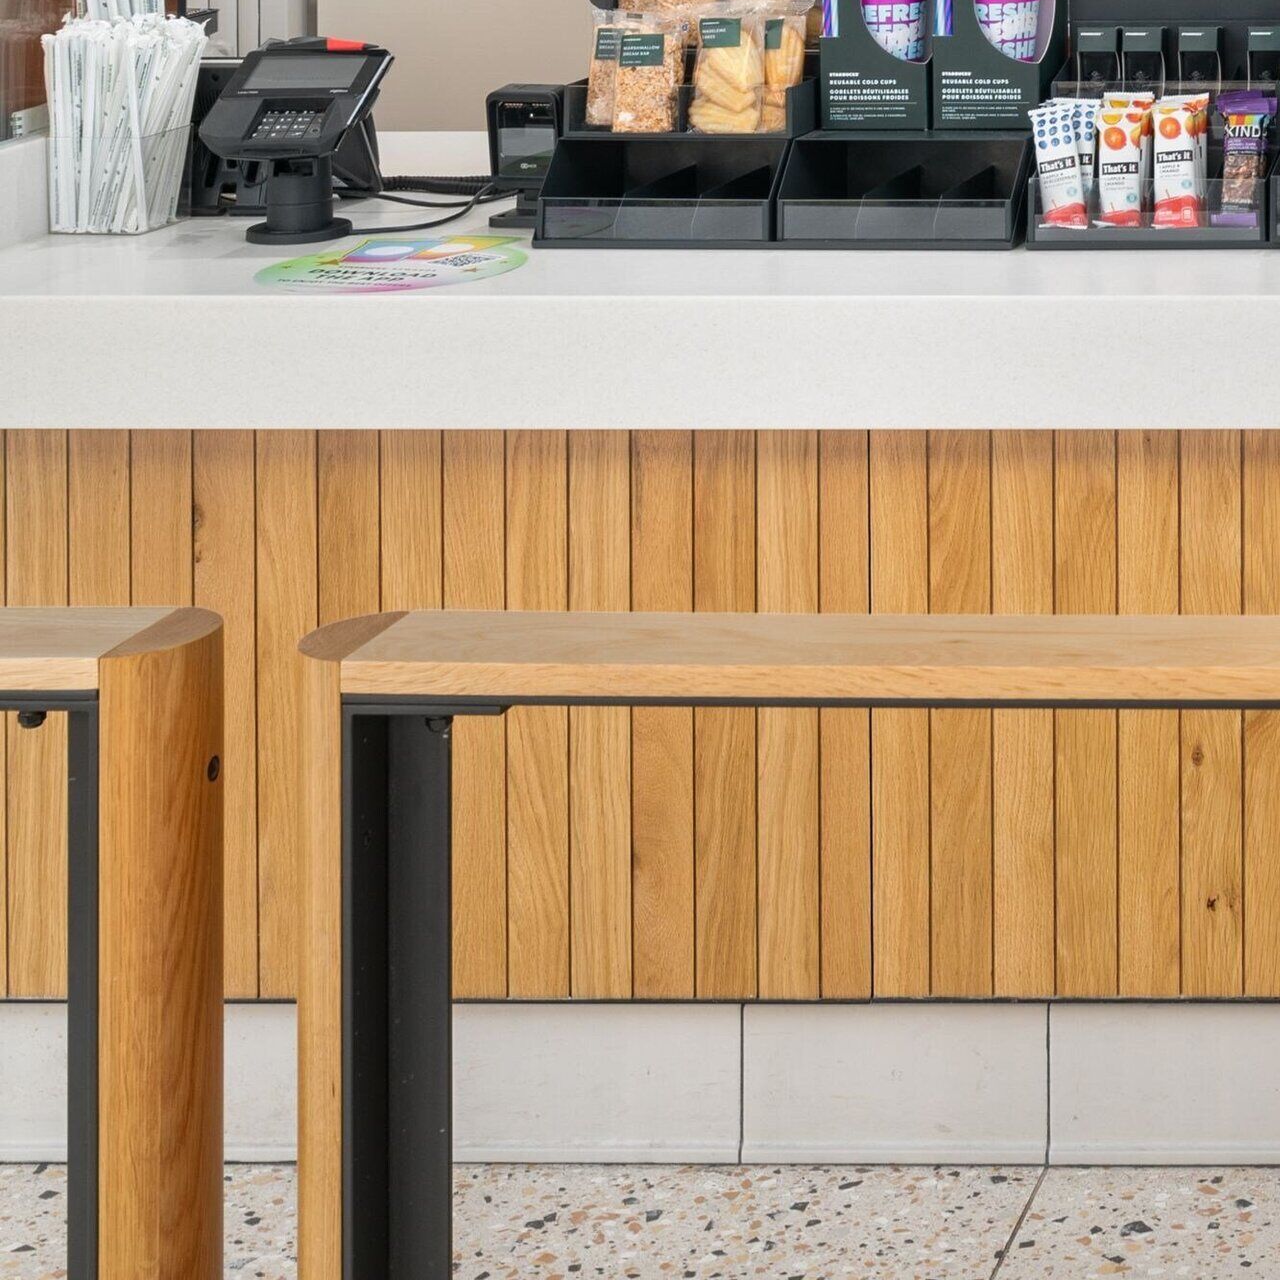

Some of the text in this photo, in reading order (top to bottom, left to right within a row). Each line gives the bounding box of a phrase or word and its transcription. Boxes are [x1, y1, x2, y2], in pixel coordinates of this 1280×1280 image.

[1226, 125, 1261, 138] KIND
[1158, 152, 1191, 162] That's it
[1040, 158, 1074, 172] That's it
[1103, 164, 1136, 173] That's it
[308, 269, 437, 278] DOWNLOAD
